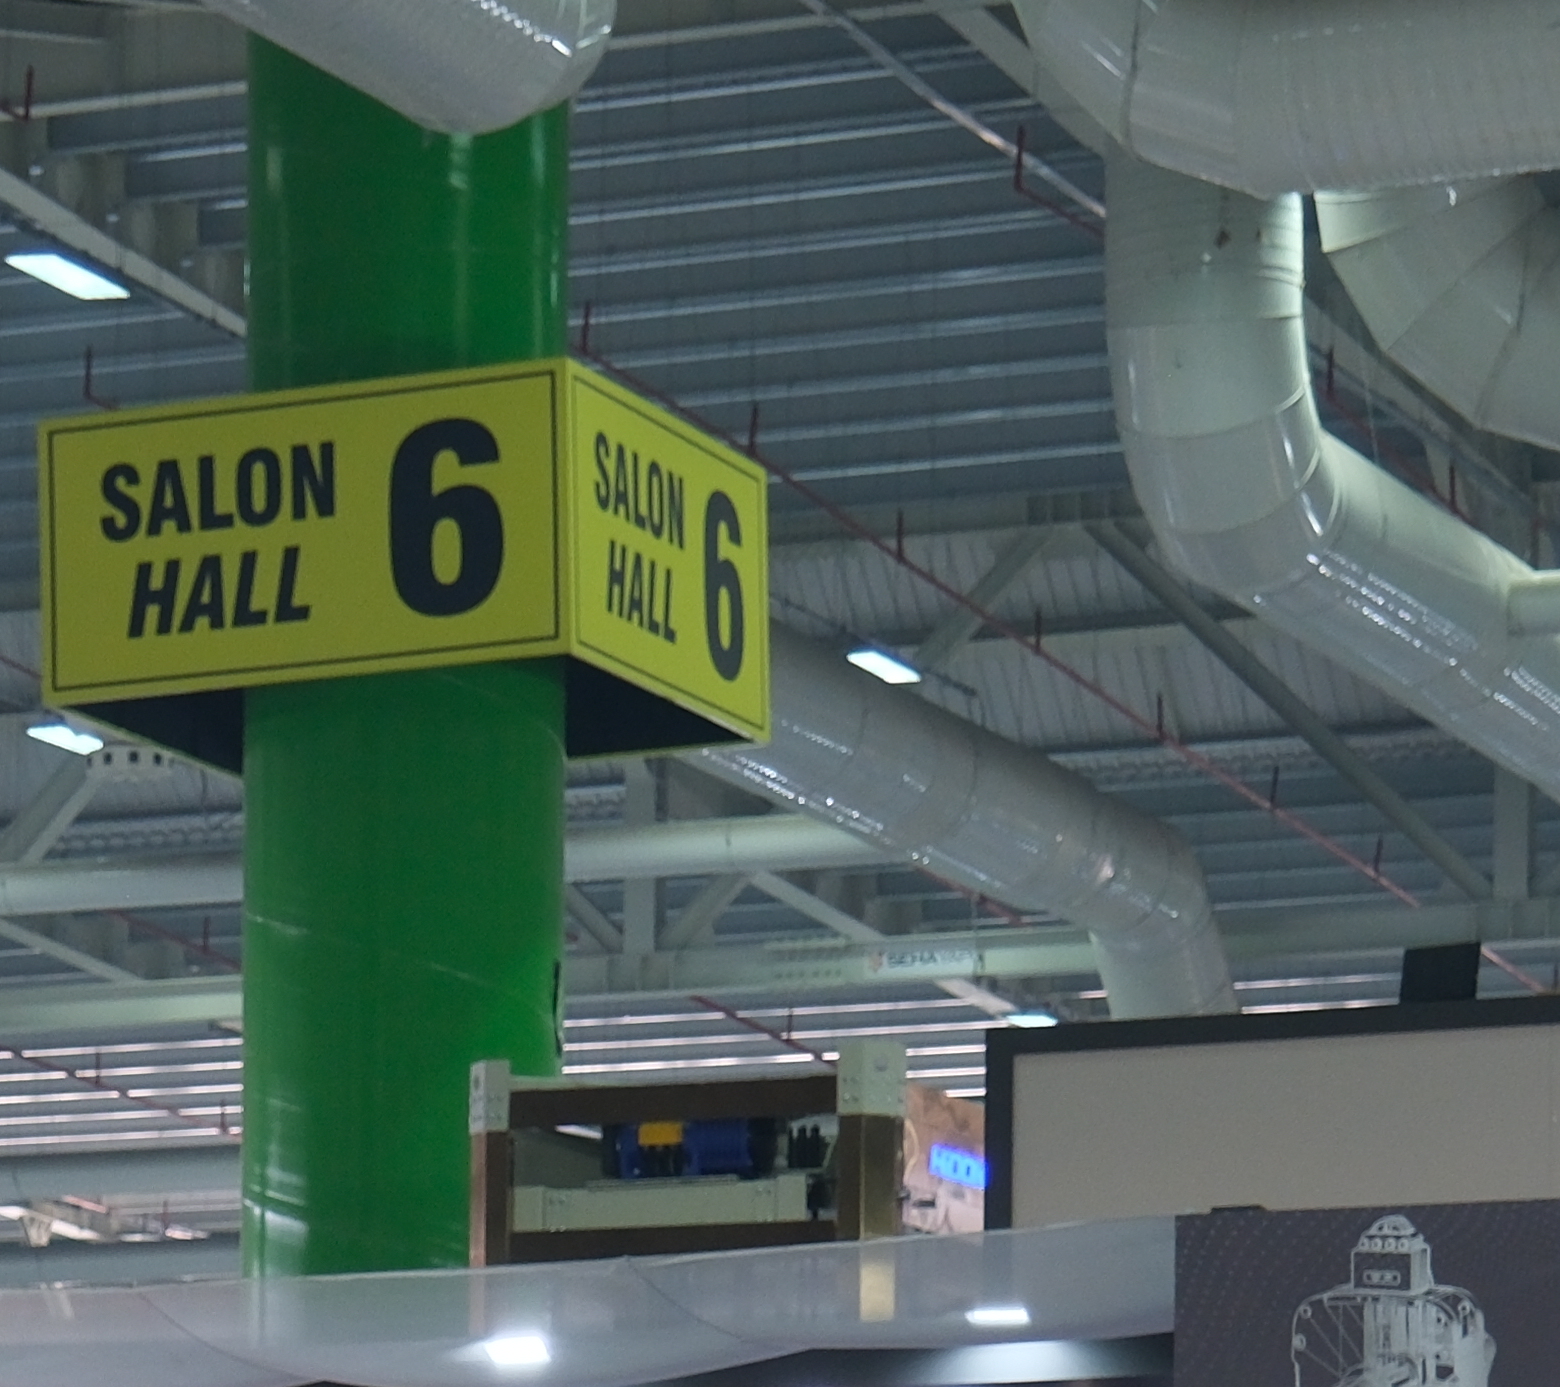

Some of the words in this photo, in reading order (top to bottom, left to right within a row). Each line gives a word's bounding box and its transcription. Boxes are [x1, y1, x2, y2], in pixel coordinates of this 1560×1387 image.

[100, 440, 336, 542] SALON
[388, 417, 505, 618] 6
[593, 430, 684, 551] SALON
[126, 545, 312, 640] HALL
[607, 539, 678, 645] HALL
[702, 489, 745, 683] 6
